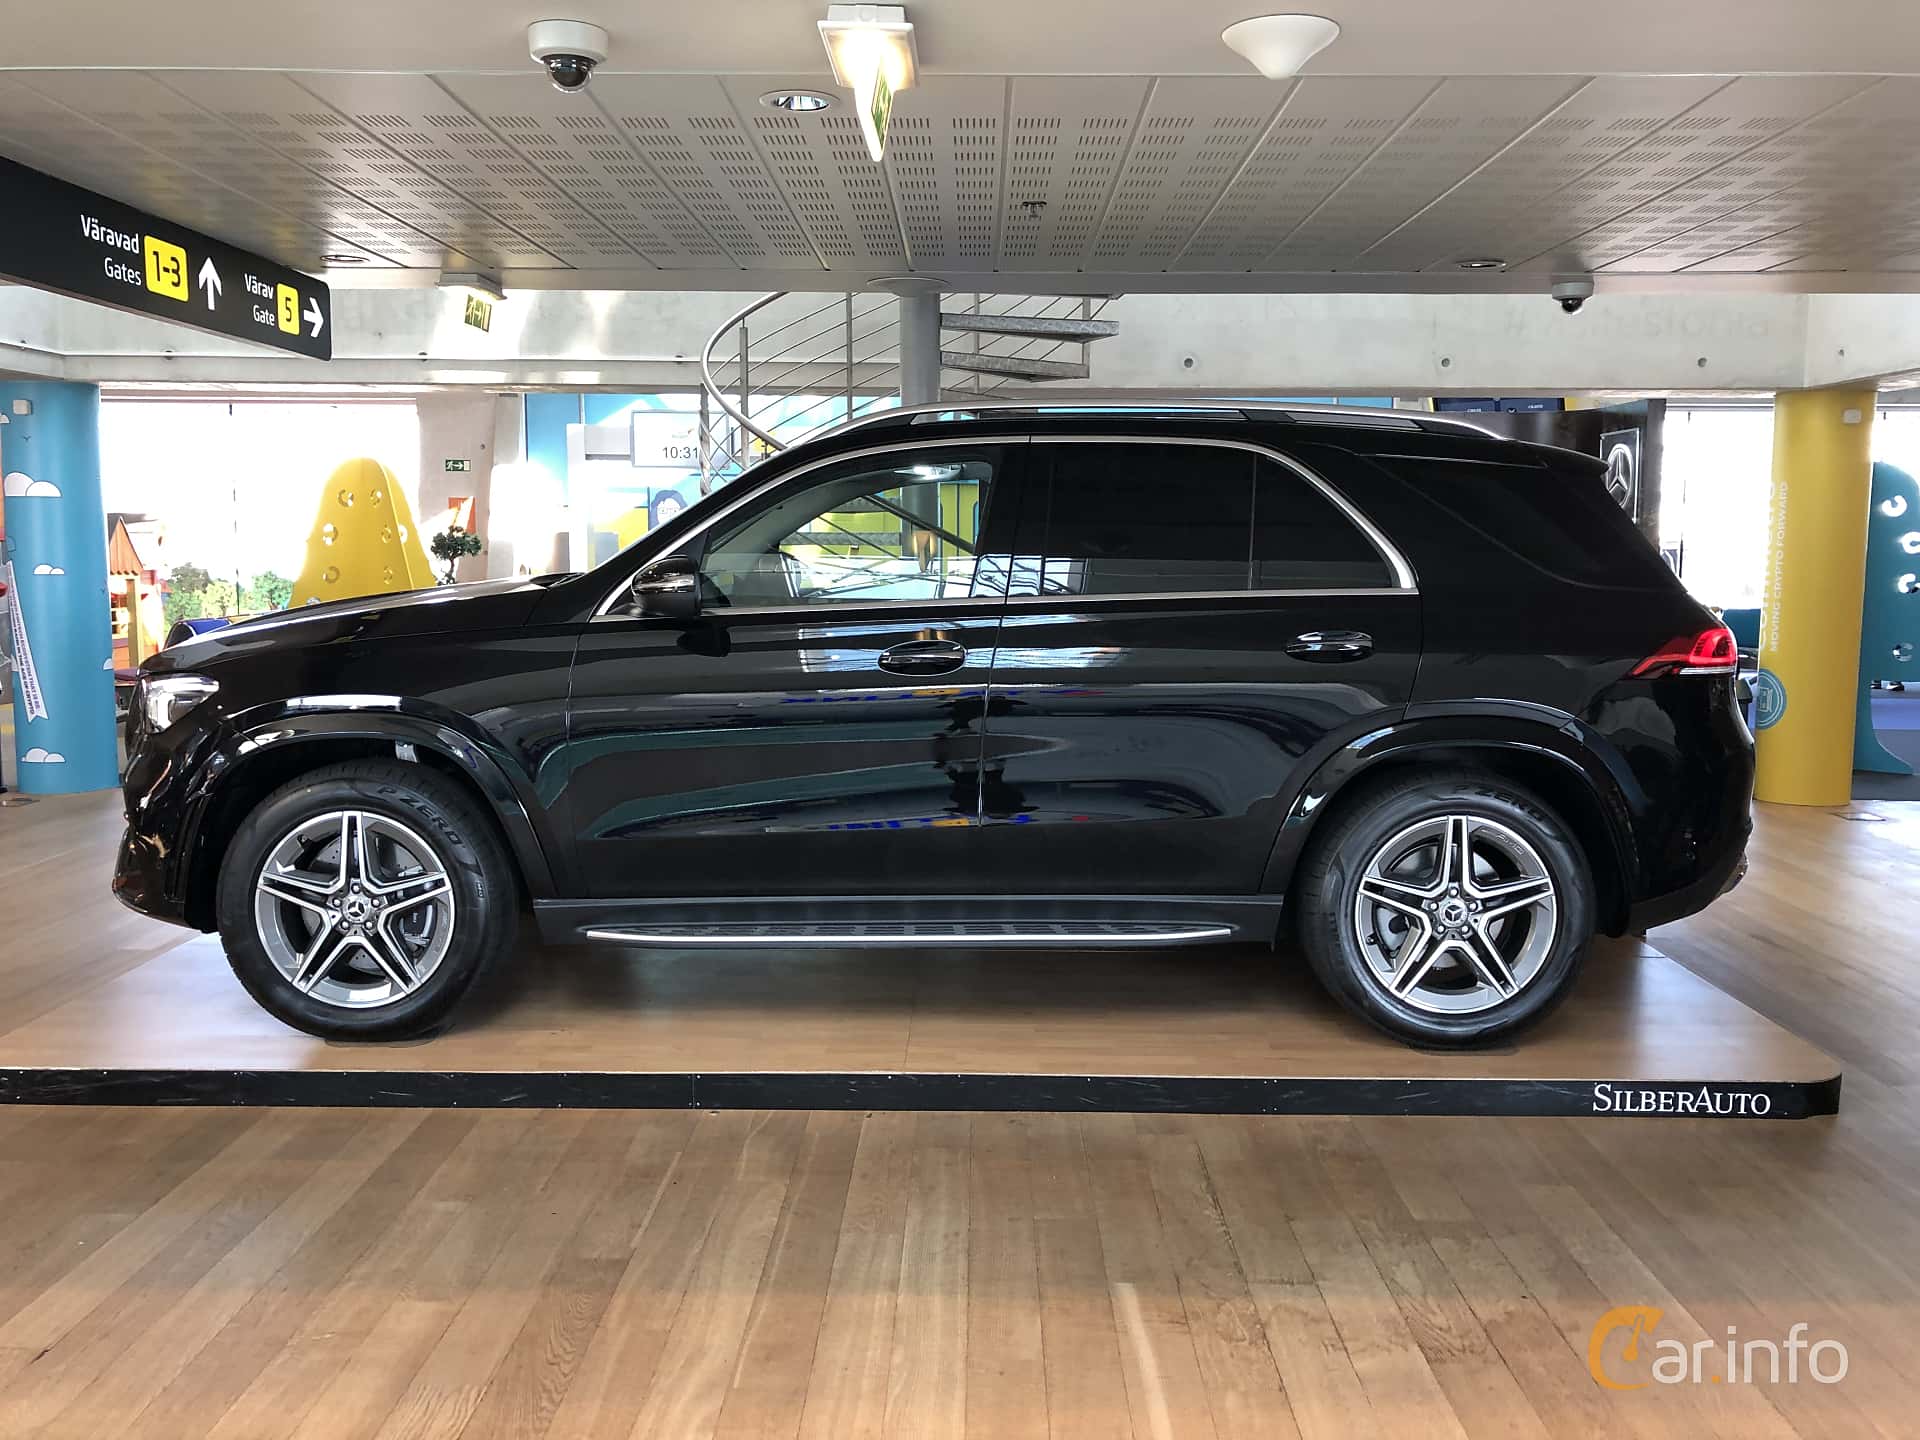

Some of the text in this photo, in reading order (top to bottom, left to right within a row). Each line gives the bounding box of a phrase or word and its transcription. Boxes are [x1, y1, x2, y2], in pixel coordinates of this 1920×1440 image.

[80, 214, 139, 254] Väravad
[104, 257, 142, 286] Gates
[152, 250, 181, 288] 1-3
[244, 273, 274, 300] Värav
[253, 304, 276, 327] Gate
[284, 297, 292, 323] 5
[662, 446, 698, 459] 10:31
[1771, 480, 1789, 651] MOVING CRYPTO FORWARD
[398, 794, 464, 845] ZERO
